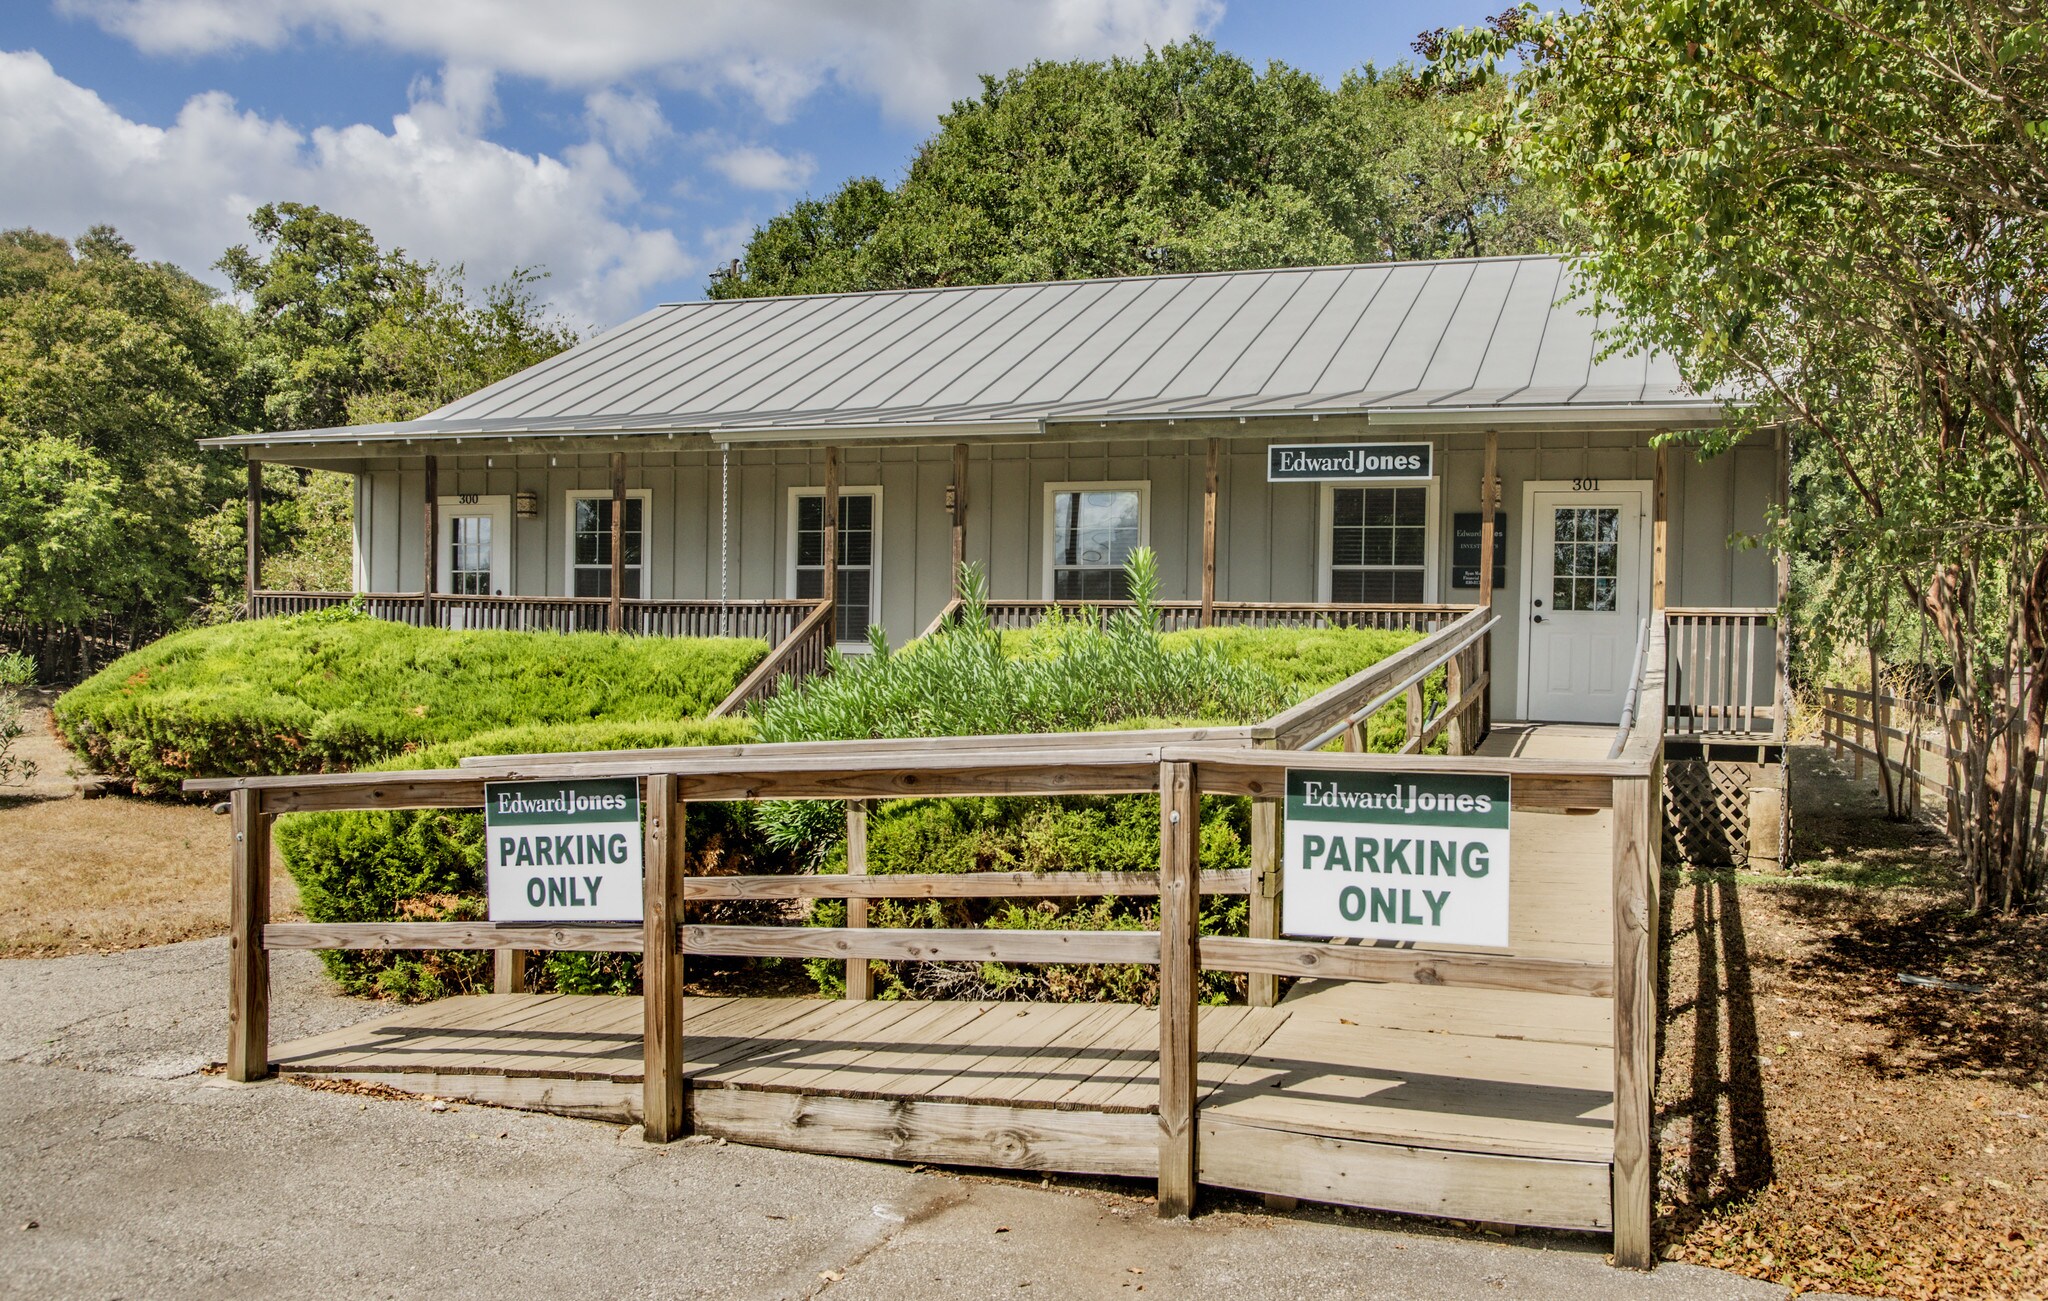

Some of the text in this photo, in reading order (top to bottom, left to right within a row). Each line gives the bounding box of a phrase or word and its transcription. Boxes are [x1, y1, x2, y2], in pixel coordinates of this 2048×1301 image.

[459, 494, 479, 505] 300
[1572, 478, 1600, 491] 301
[500, 833, 628, 867] PARKING
[1302, 834, 1490, 879] PARKING
[526, 875, 603, 908] ONLY
[1338, 885, 1451, 927] ONLY
